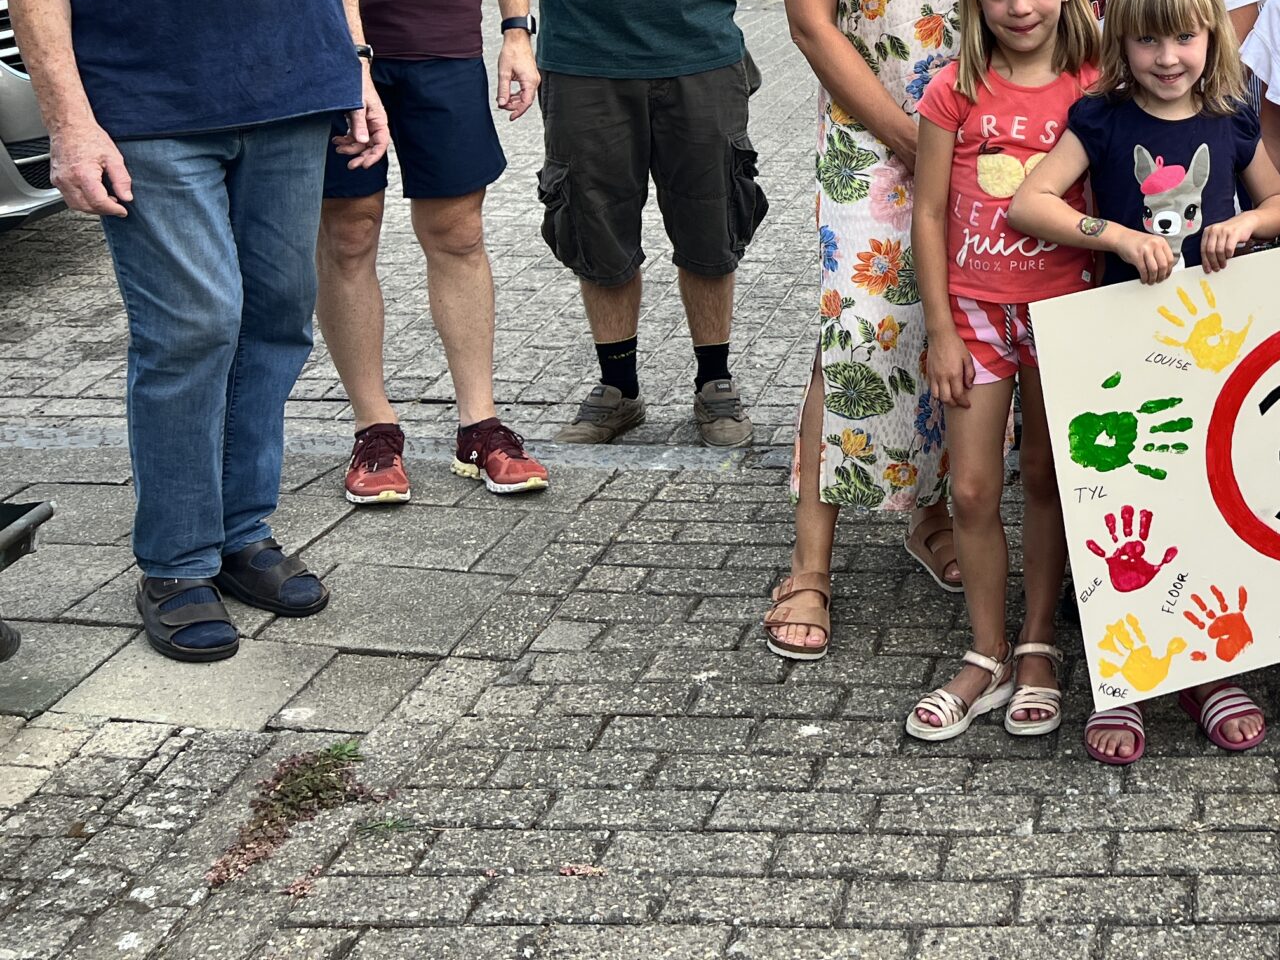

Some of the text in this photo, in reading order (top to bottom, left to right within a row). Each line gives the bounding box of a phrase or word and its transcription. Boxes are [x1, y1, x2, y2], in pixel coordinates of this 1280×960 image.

[956, 228, 1059, 268] juic
[1009, 258, 1045, 271] PURE
[1145, 352, 1192, 371] LOUISE
[1074, 486, 1108, 503] TYL
[1079, 576, 1103, 604] ELLIE
[1161, 571, 1189, 615] FLOOR
[1098, 682, 1129, 700] KOBE
